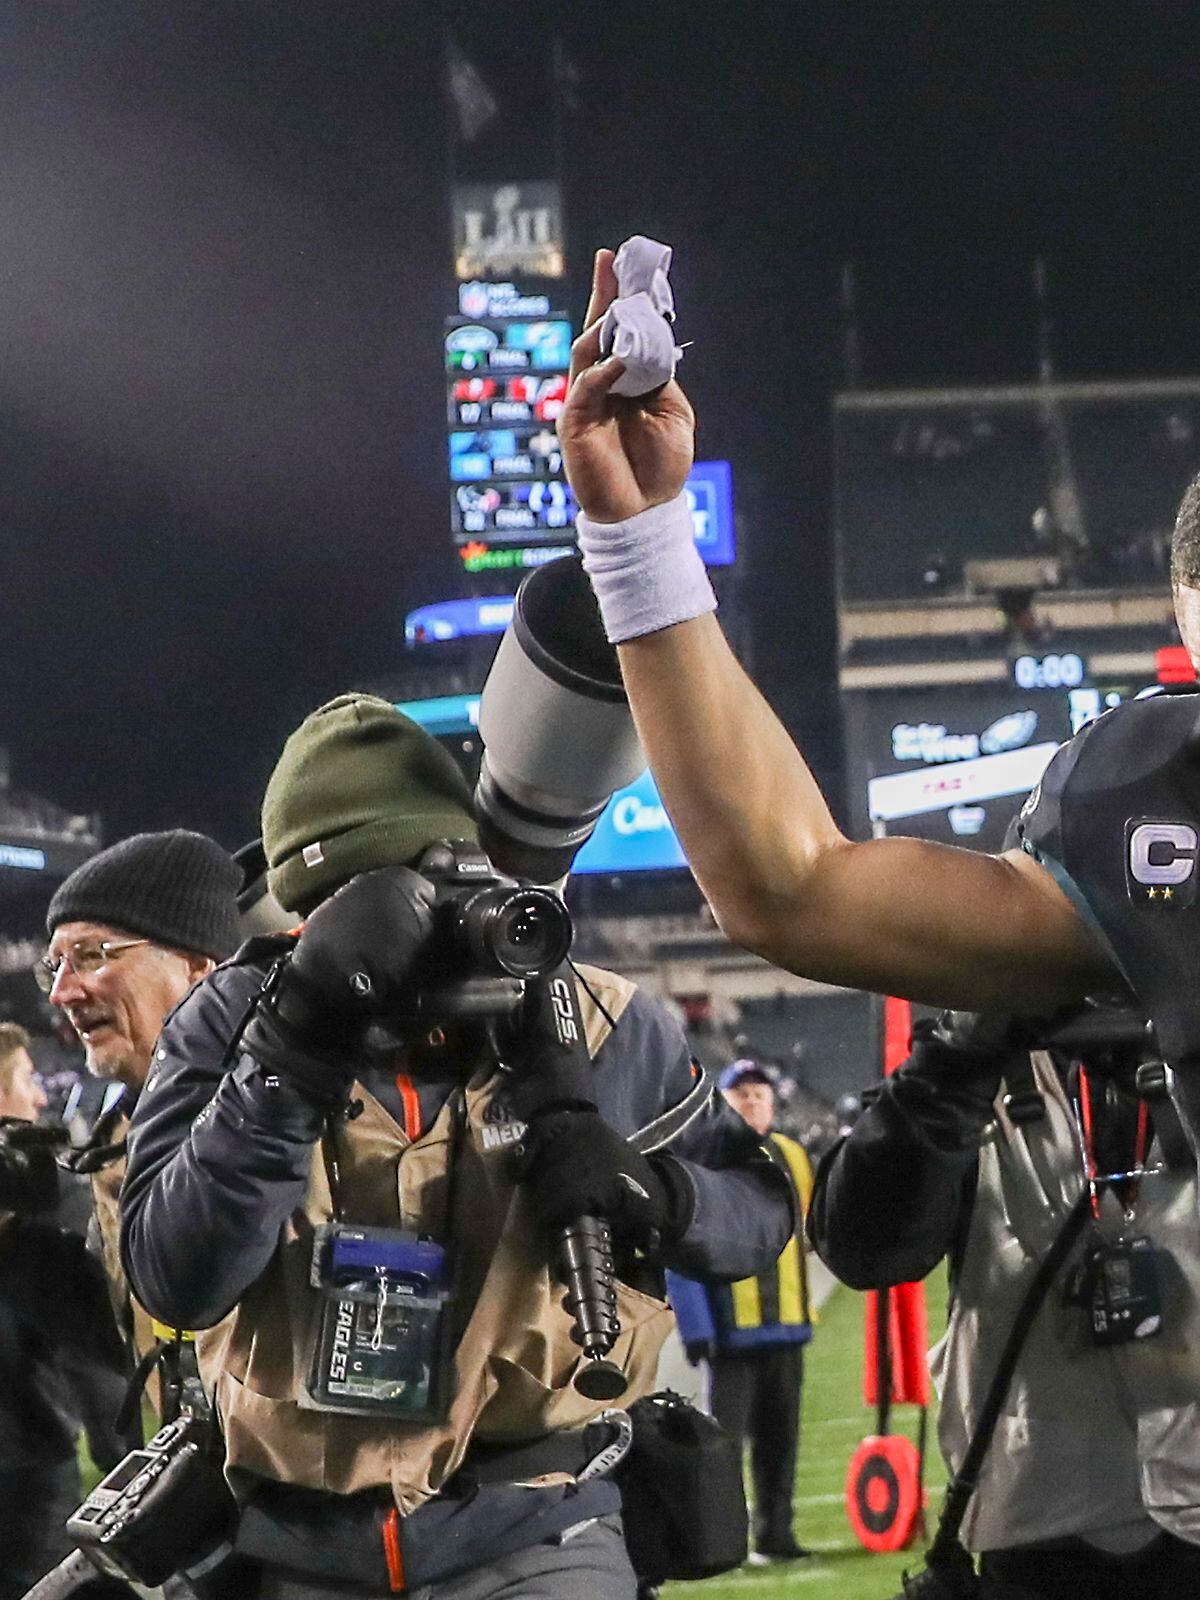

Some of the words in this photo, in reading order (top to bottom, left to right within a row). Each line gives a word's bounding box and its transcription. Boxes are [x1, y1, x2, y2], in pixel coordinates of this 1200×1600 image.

[1015, 653, 1083, 688] 0:00
[458, 863, 488, 872] Canon
[1130, 824, 1198, 885] C
[330, 1300, 354, 1383] EAGLES
[353, 1361, 363, 1371] C
